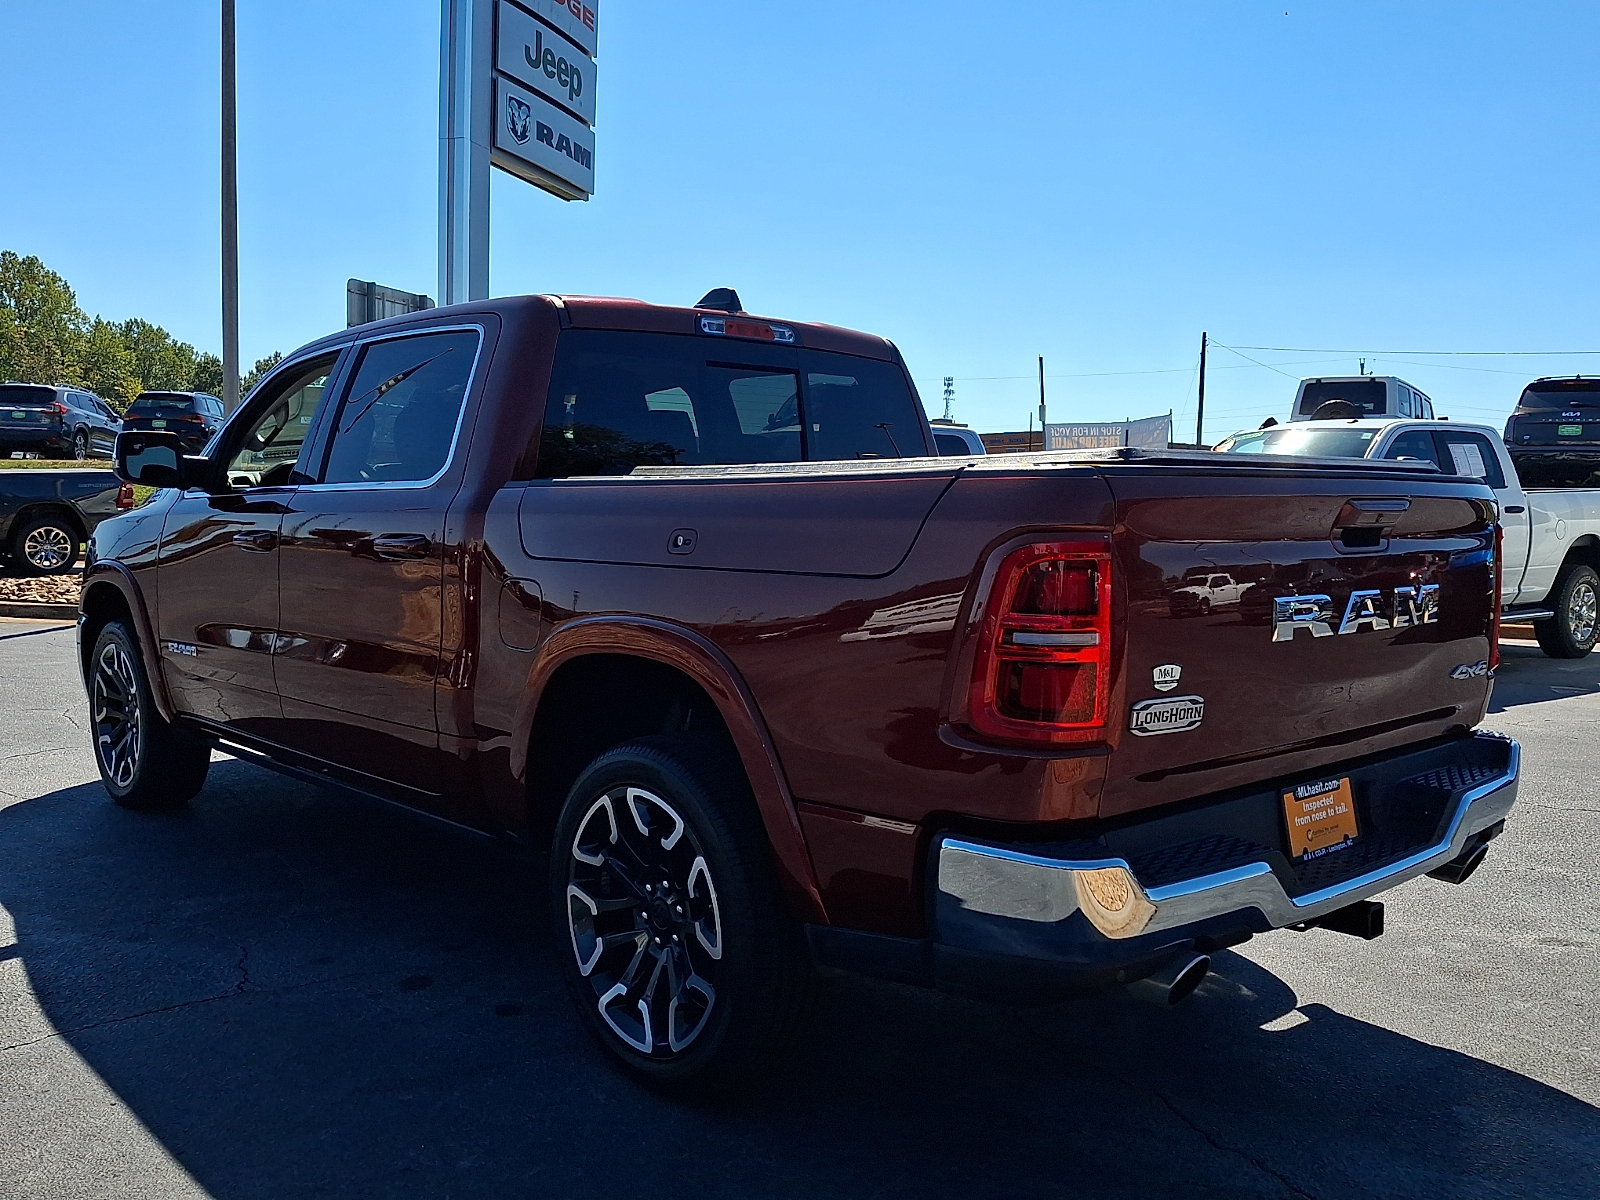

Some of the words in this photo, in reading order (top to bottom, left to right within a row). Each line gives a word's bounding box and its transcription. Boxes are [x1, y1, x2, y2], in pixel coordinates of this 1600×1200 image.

[525, 29, 583, 101] Jeep
[536, 120, 592, 171] RAM
[1272, 584, 1440, 643] RAM
[168, 643, 197, 657] RAM
[1158, 668, 1176, 679] M&L
[1134, 706, 1203, 728] LONGHORN
[1294, 816, 1311, 827] from
[1311, 811, 1327, 822] nose
[1328, 807, 1335, 816] to
[1335, 802, 1348, 814] tail.
[1302, 794, 1334, 812] Inspected
